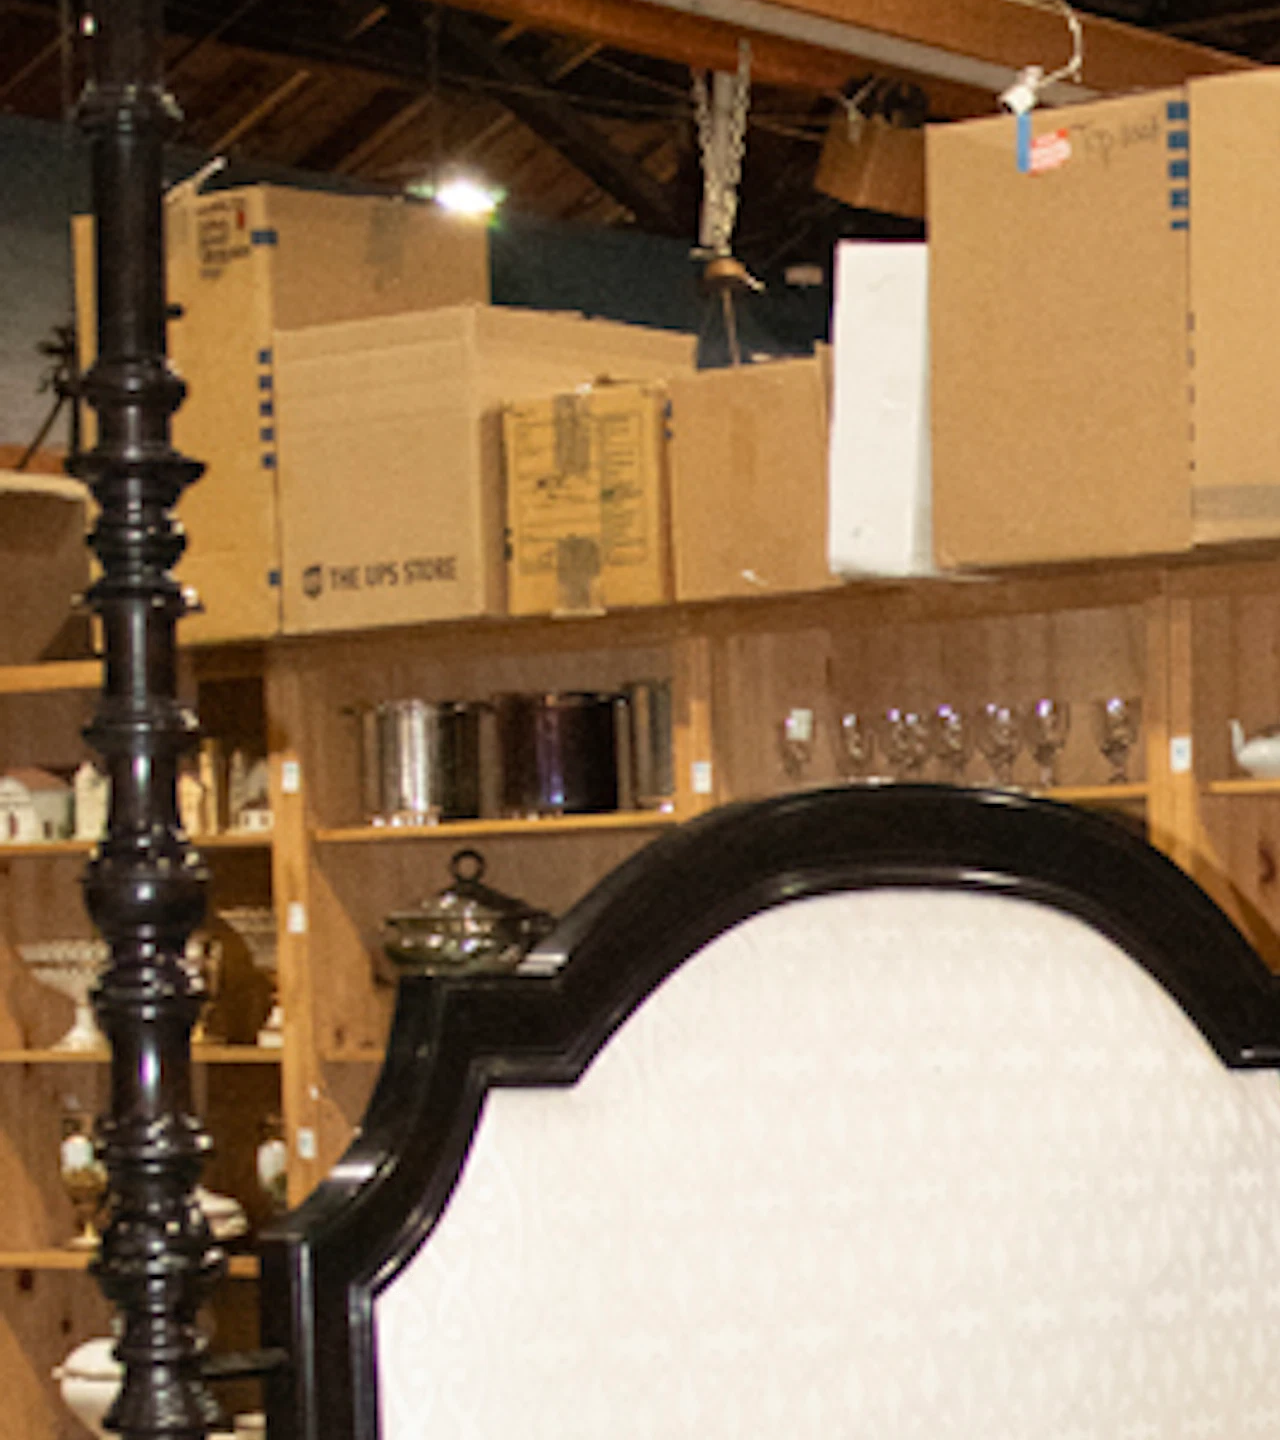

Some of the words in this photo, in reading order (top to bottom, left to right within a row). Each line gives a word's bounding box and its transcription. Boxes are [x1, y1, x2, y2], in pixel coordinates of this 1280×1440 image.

[329, 564, 361, 591] THE
[365, 560, 400, 587] UPS
[403, 556, 458, 586] STORE
